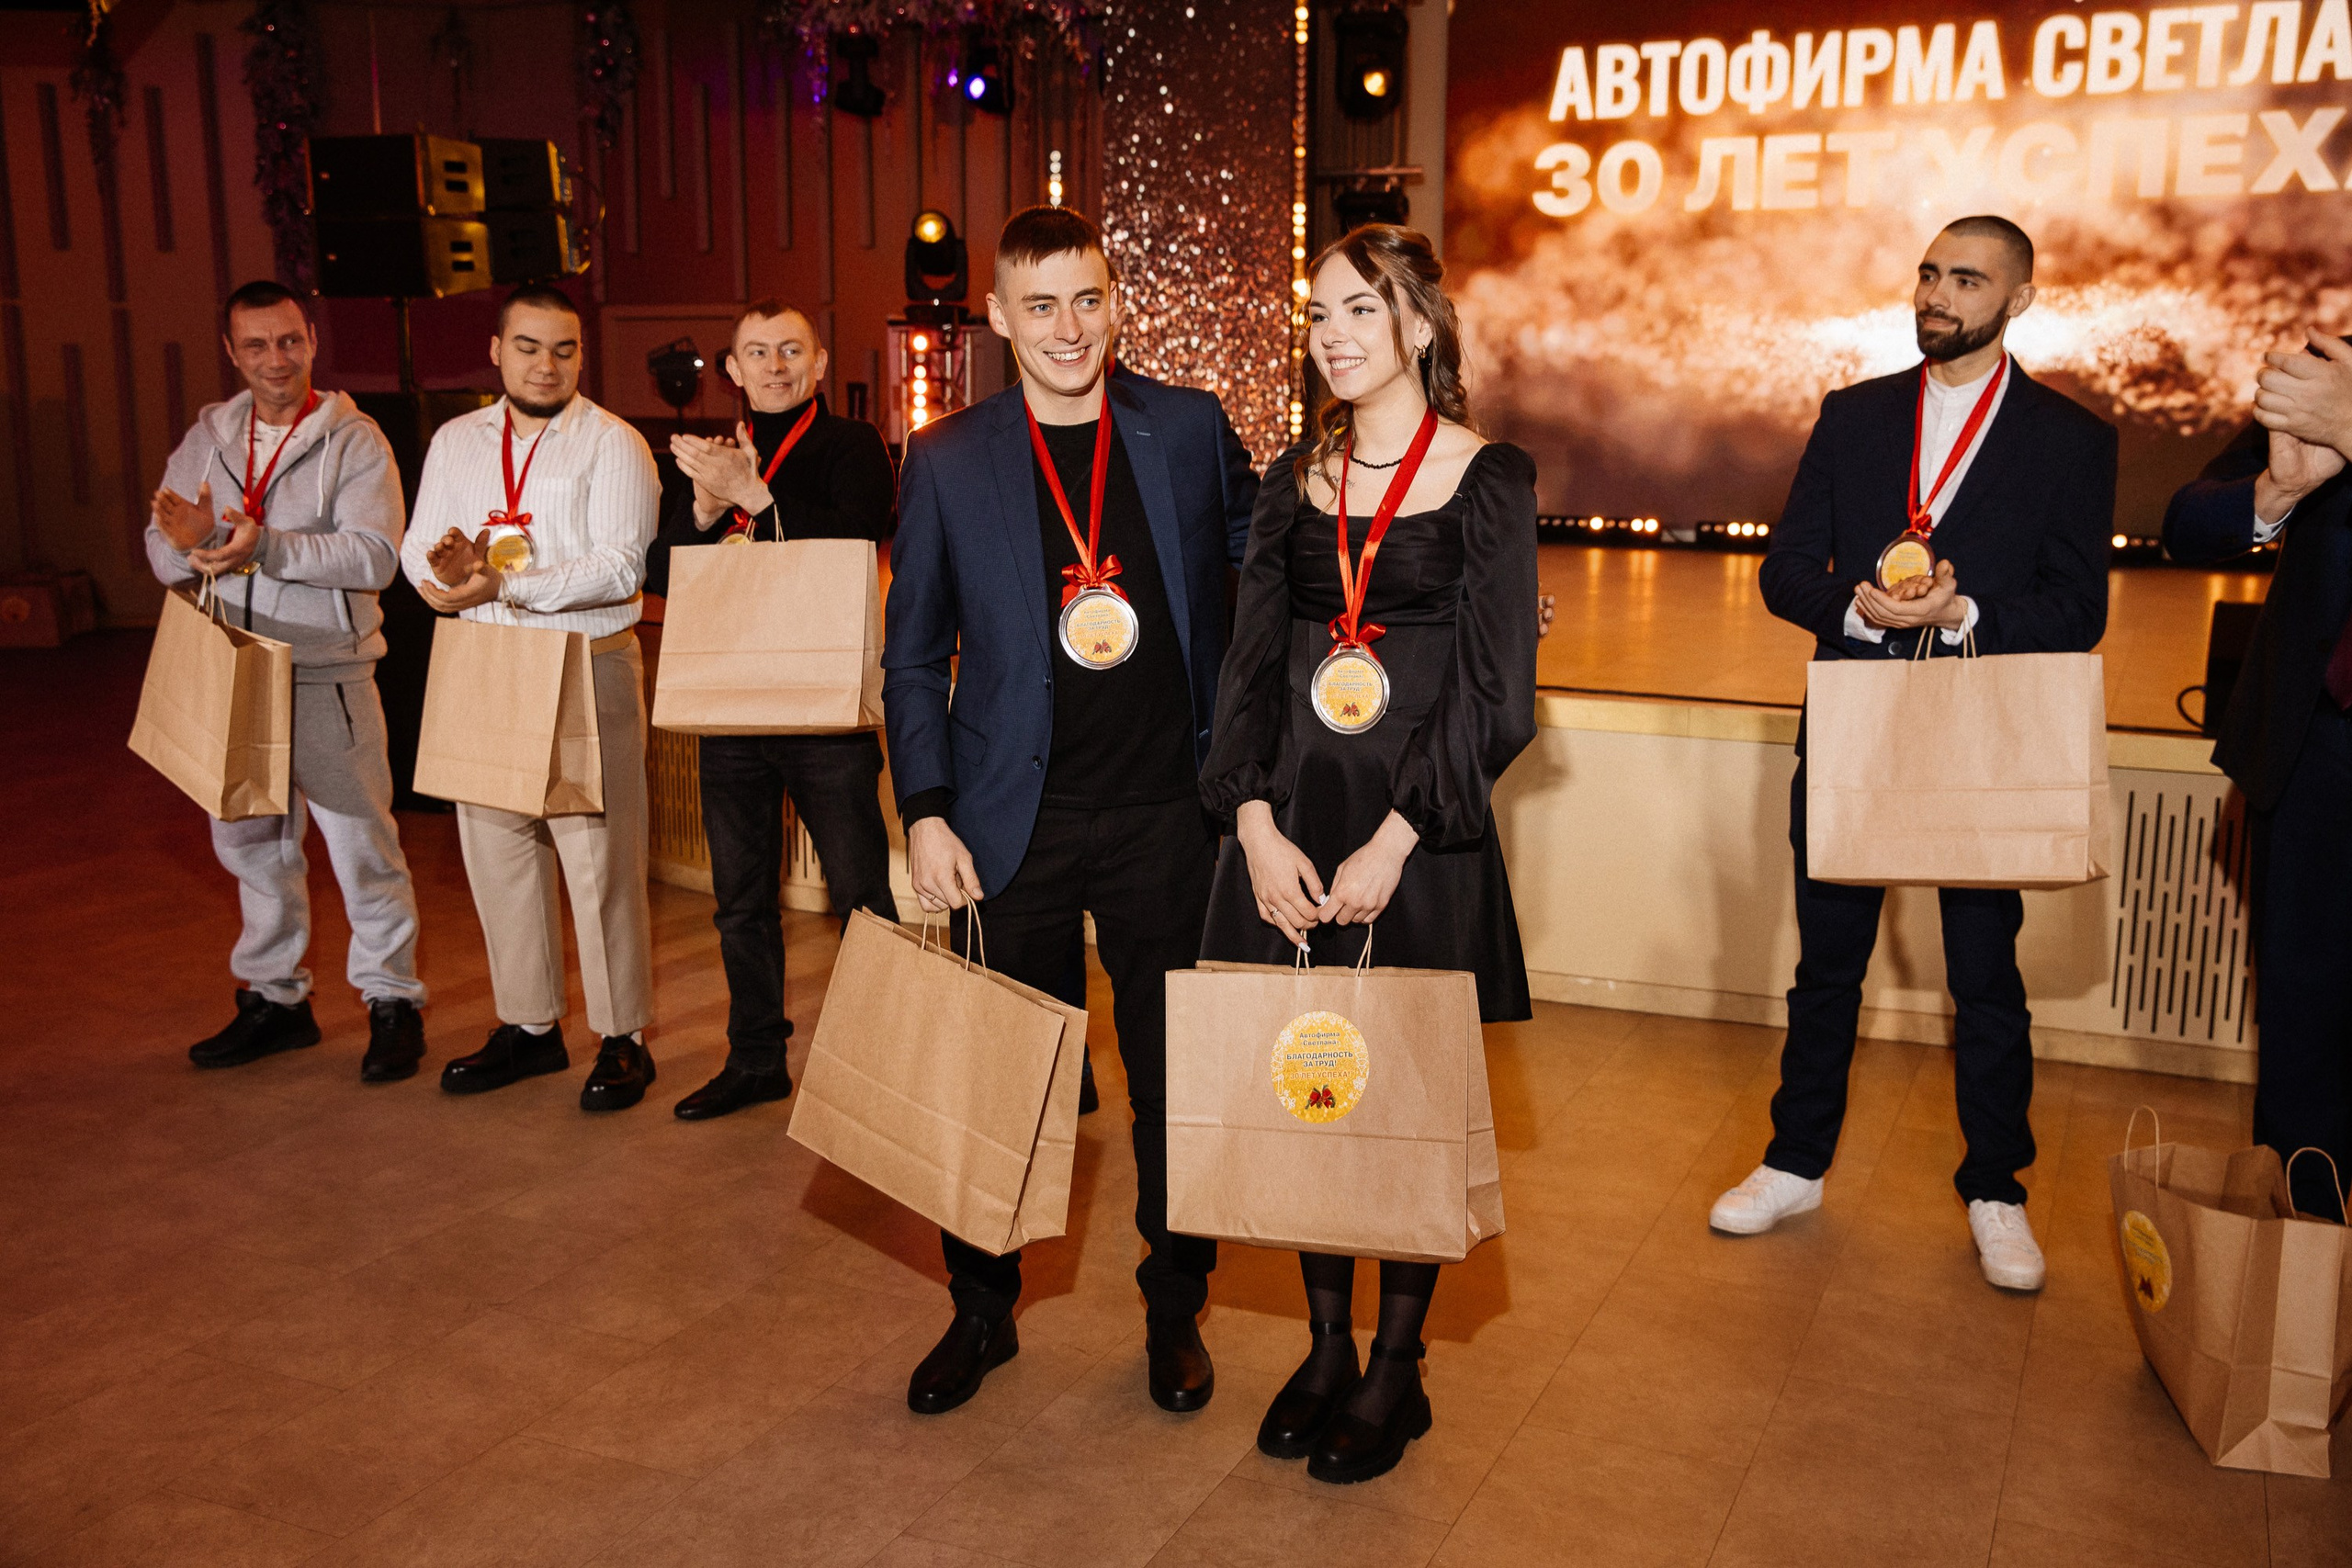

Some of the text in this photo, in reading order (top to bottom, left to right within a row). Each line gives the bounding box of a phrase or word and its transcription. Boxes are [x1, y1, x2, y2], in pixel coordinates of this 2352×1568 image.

[1548, 0, 2352, 121] АВТОФИРМА СВЕТЛА
[1532, 107, 2352, 218] 30 ЛЕТ УСПЕХ
[1286, 1051, 1353, 1060] БЛАГОДАРНОСТЬ
